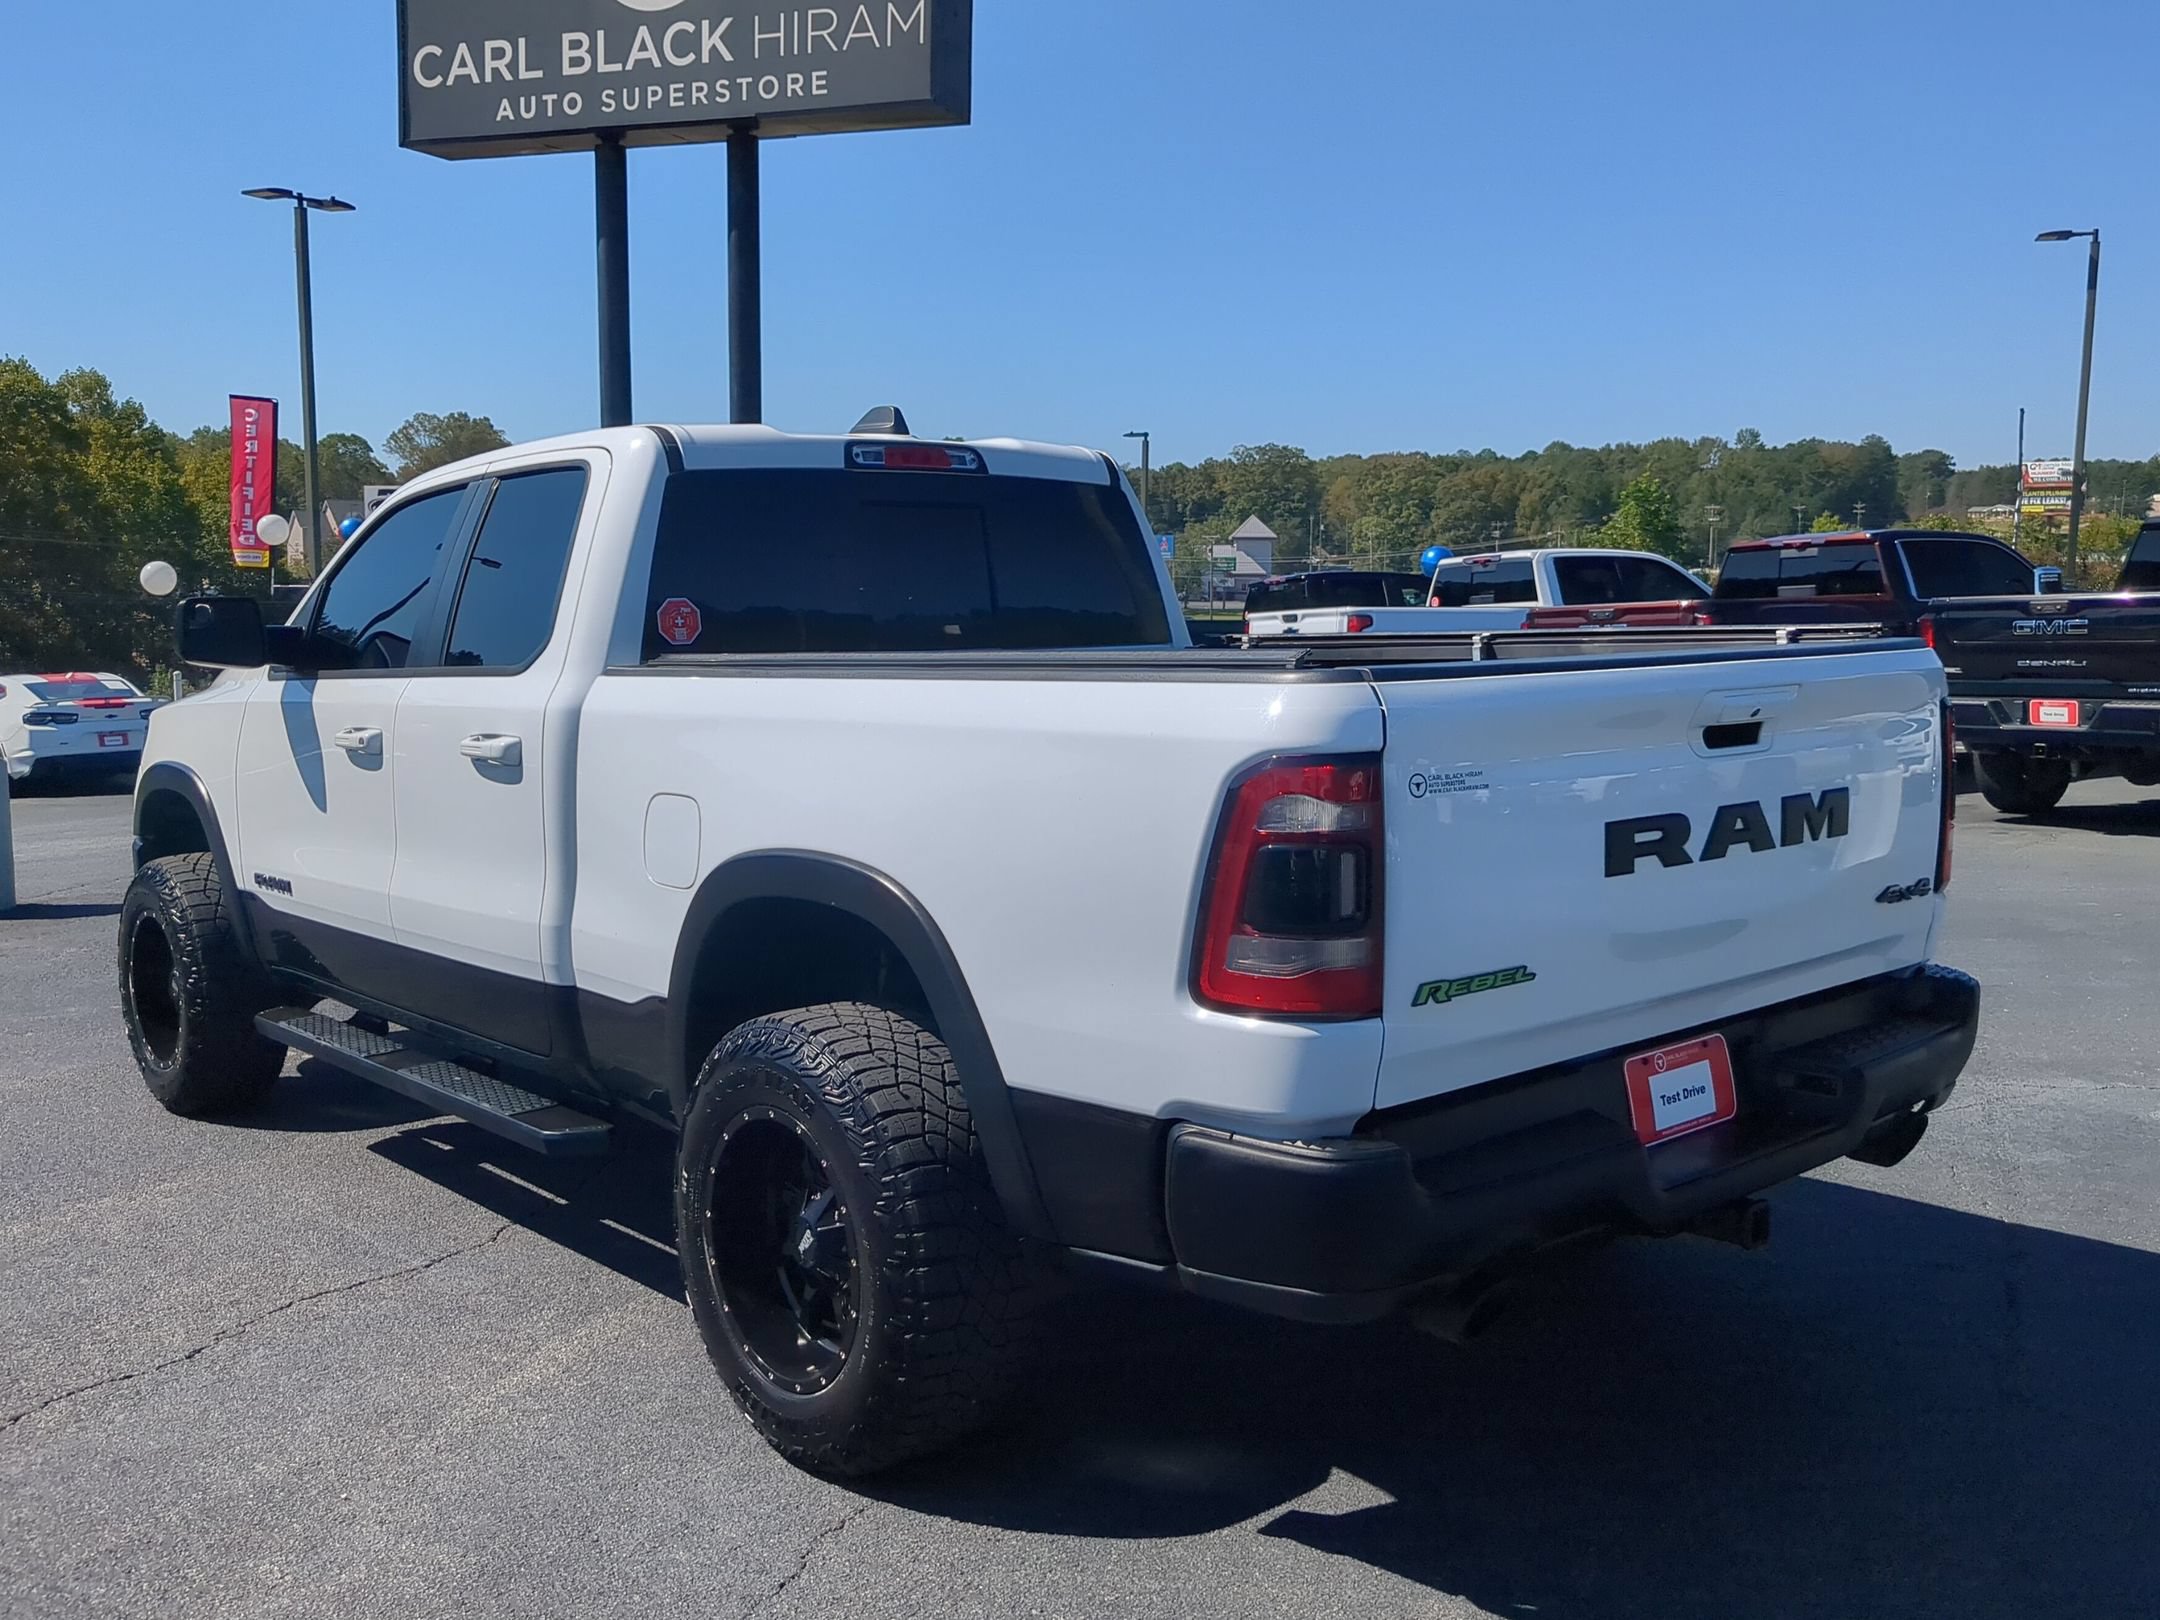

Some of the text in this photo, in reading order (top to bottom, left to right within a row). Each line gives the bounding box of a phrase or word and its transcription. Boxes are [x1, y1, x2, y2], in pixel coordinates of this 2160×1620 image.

[412, 0, 926, 89] CARL BLACK HIRAM
[495, 70, 829, 122] AUTO SUPERSTORE
[2013, 619, 2088, 635] GMC
[1444, 772, 1464, 780] BLACK
[1604, 787, 1850, 878] RAM
[1411, 965, 1537, 1007] REBEL
[1660, 1084, 1706, 1107] Test Drive
